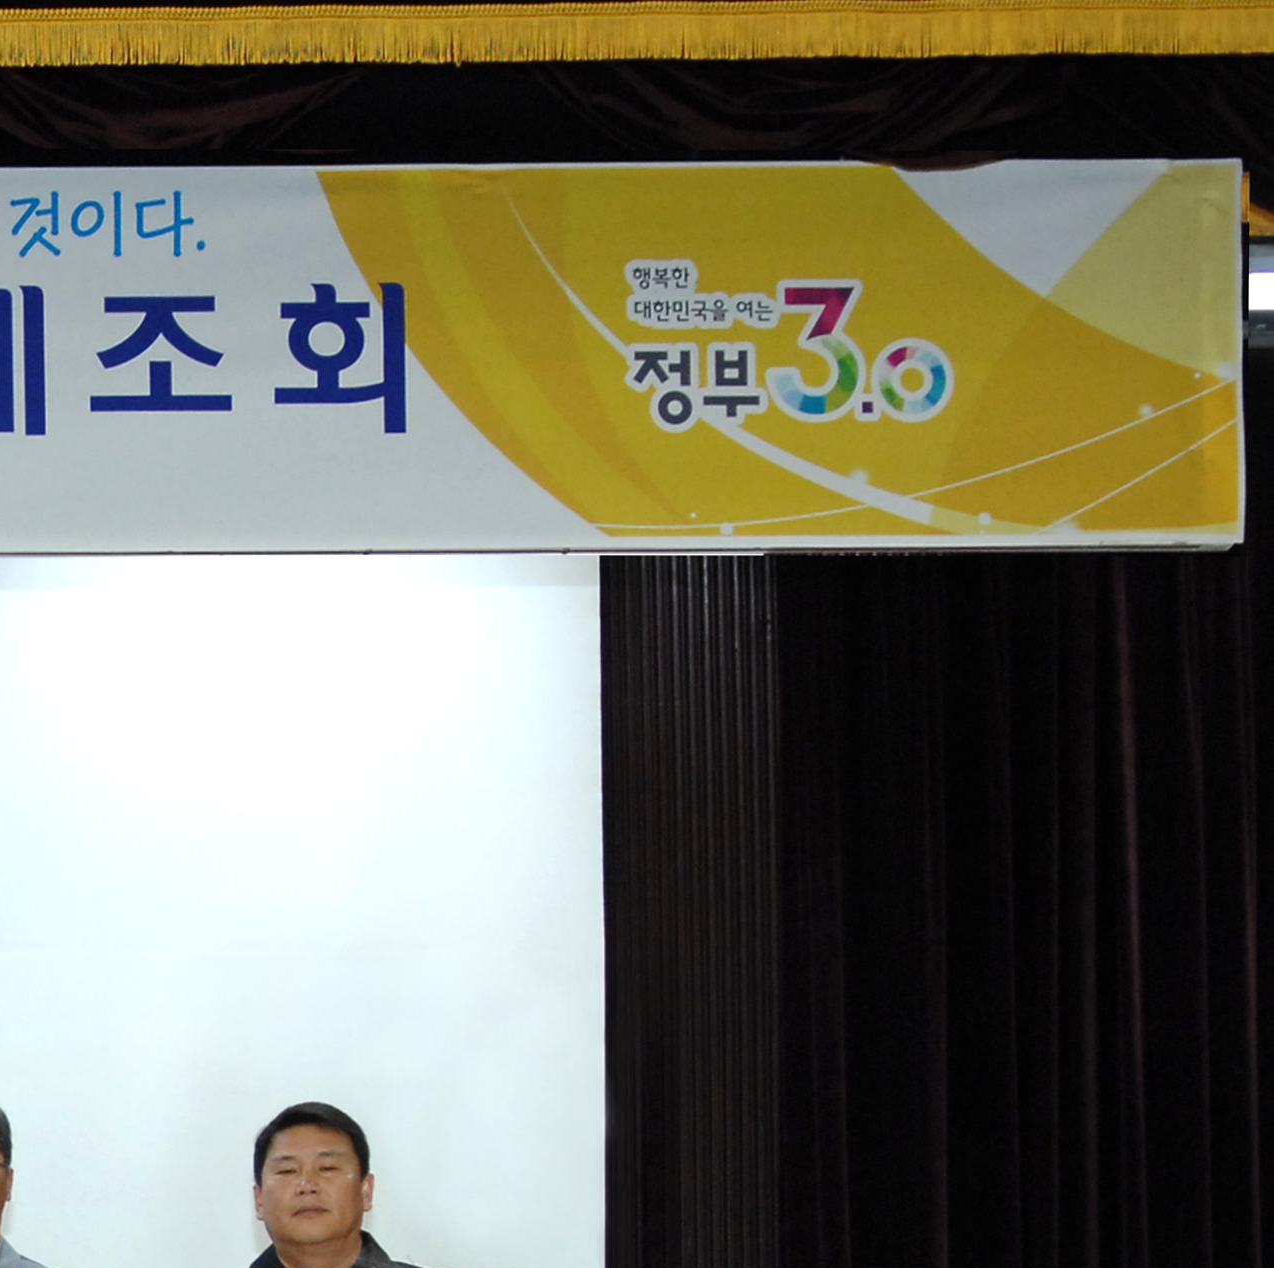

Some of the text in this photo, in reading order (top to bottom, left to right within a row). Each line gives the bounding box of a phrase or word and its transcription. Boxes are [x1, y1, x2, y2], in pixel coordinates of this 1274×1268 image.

[9, 190, 208, 259] 것이다.
[632, 266, 691, 290] 행복한
[633, 299, 774, 323] 대한민국을 여는
